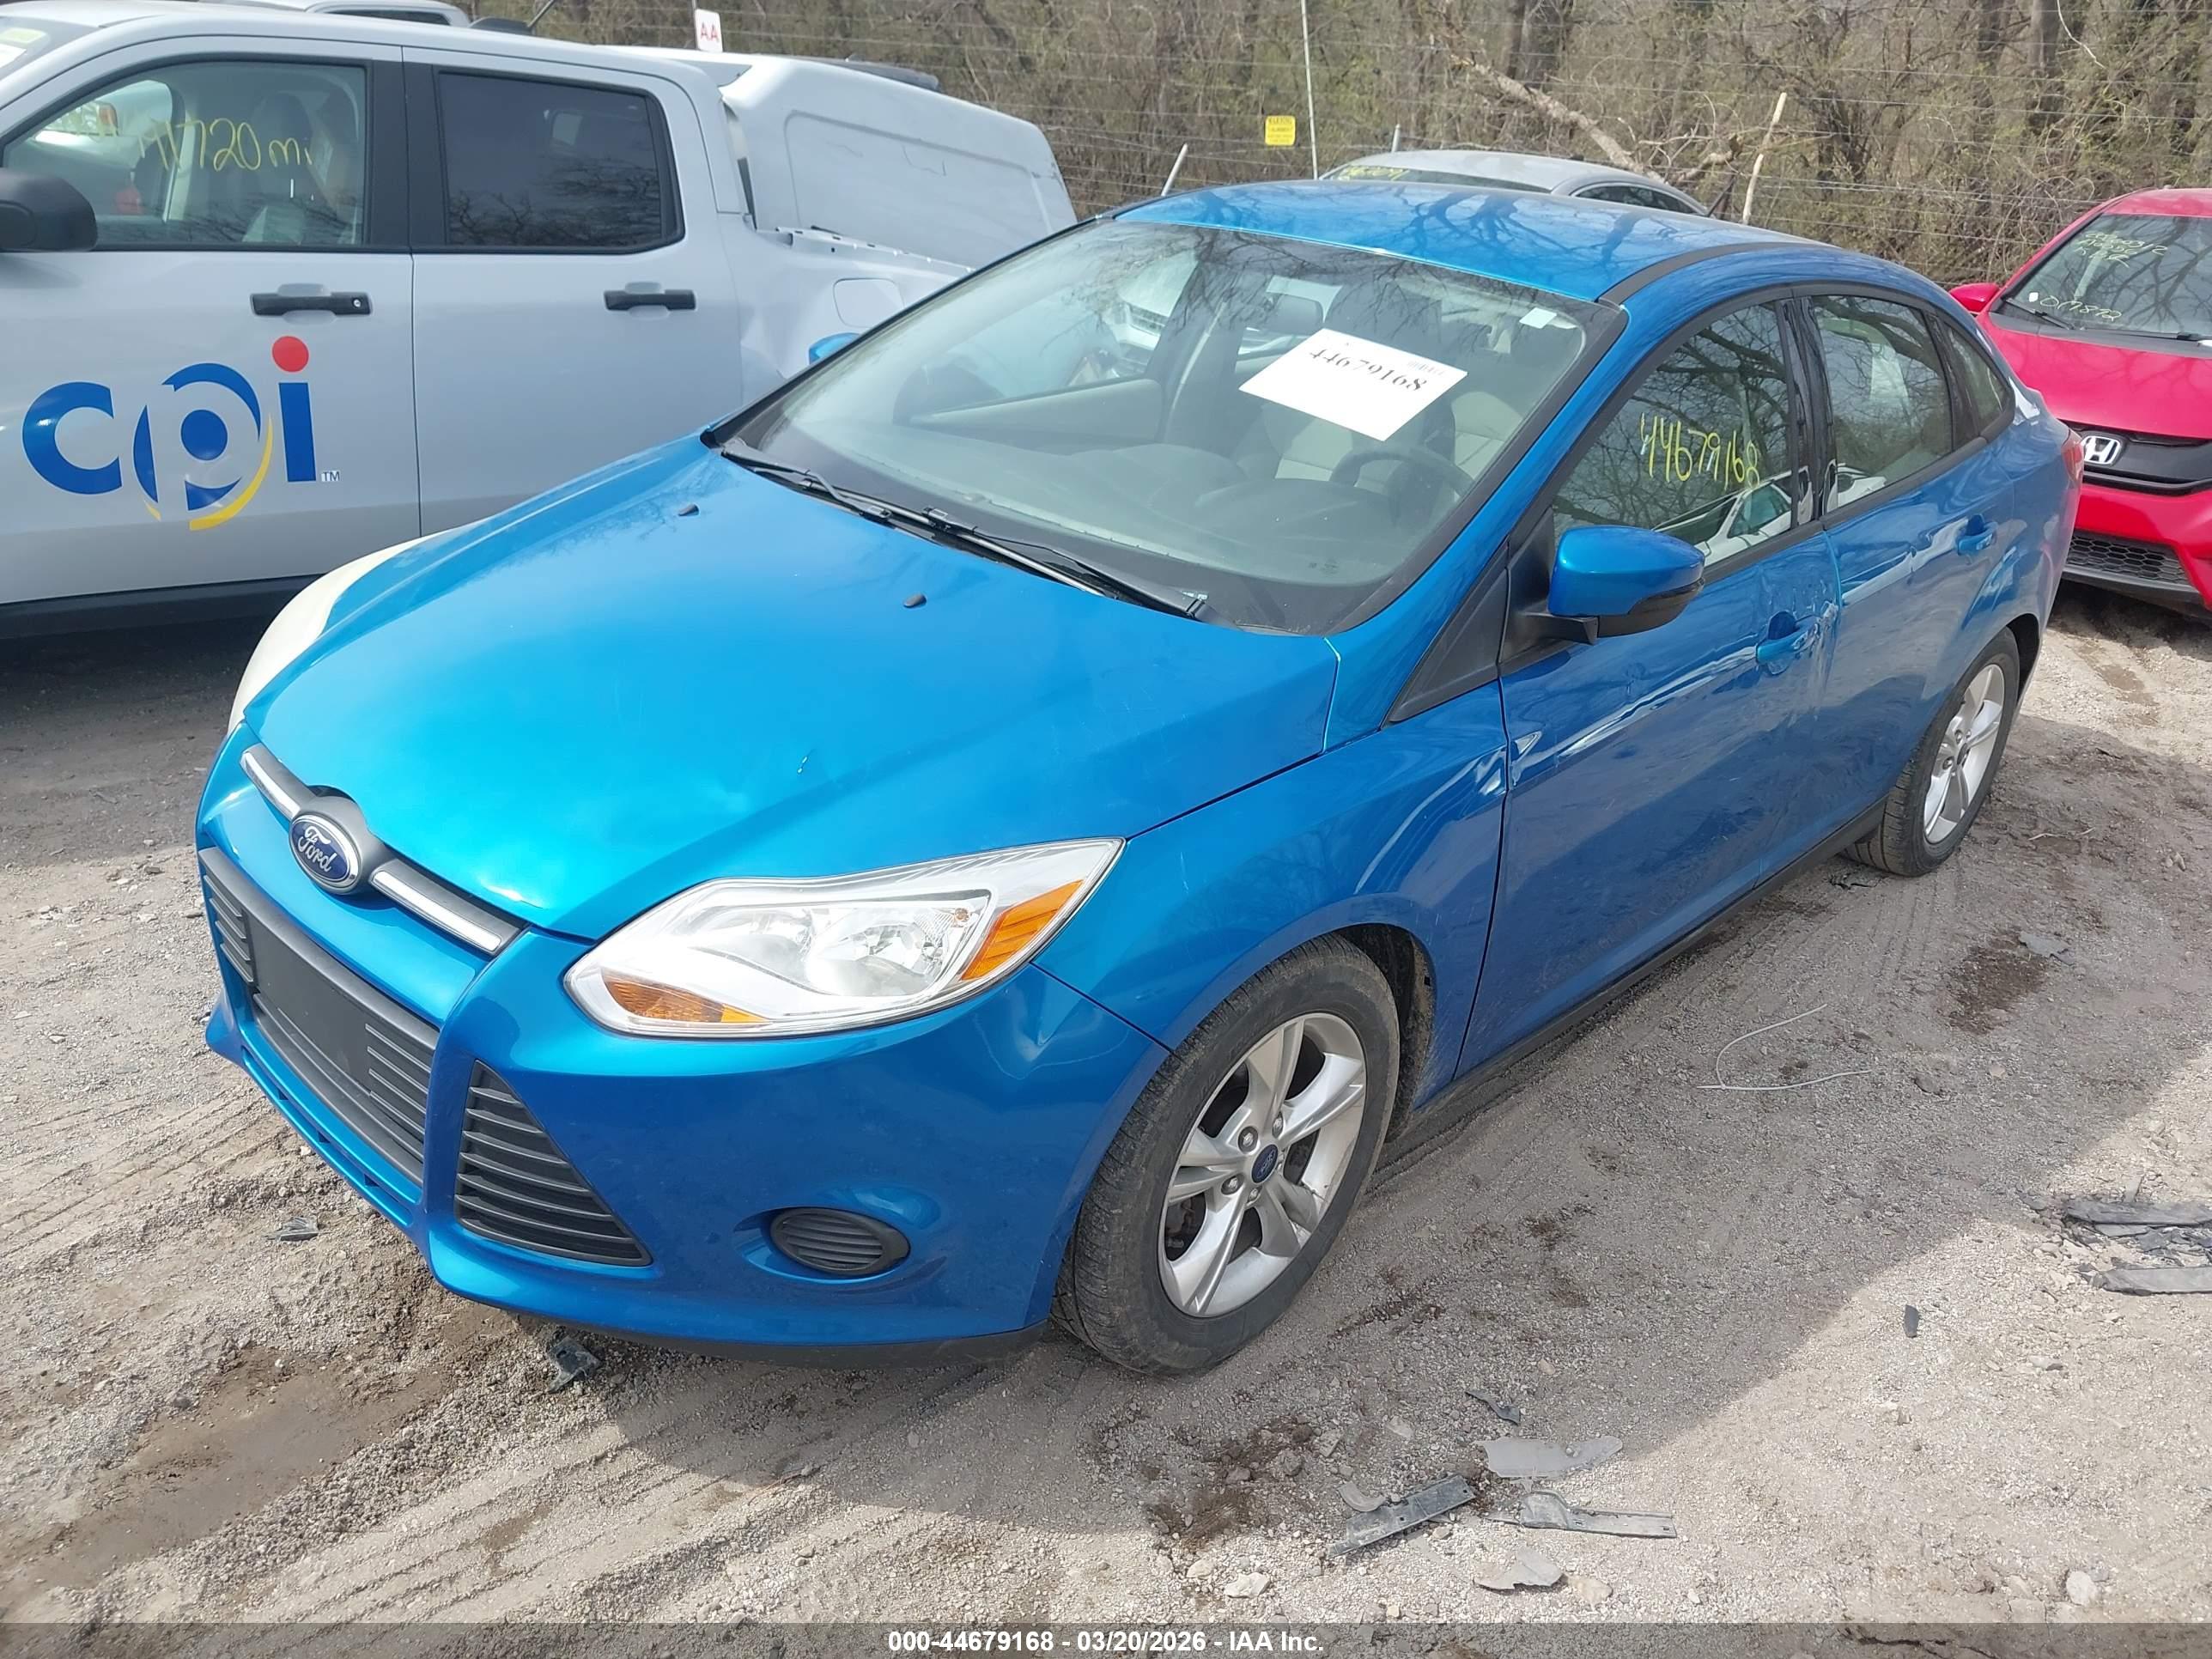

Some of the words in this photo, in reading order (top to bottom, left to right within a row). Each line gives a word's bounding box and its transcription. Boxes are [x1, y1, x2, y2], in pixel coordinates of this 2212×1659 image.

[700, 21, 720, 43] AA
[1310, 349, 1427, 392] 44679168
[22, 336, 317, 531] cpi
[1640, 412, 1760, 492] 44679168
[298, 825, 337, 872] Ford
